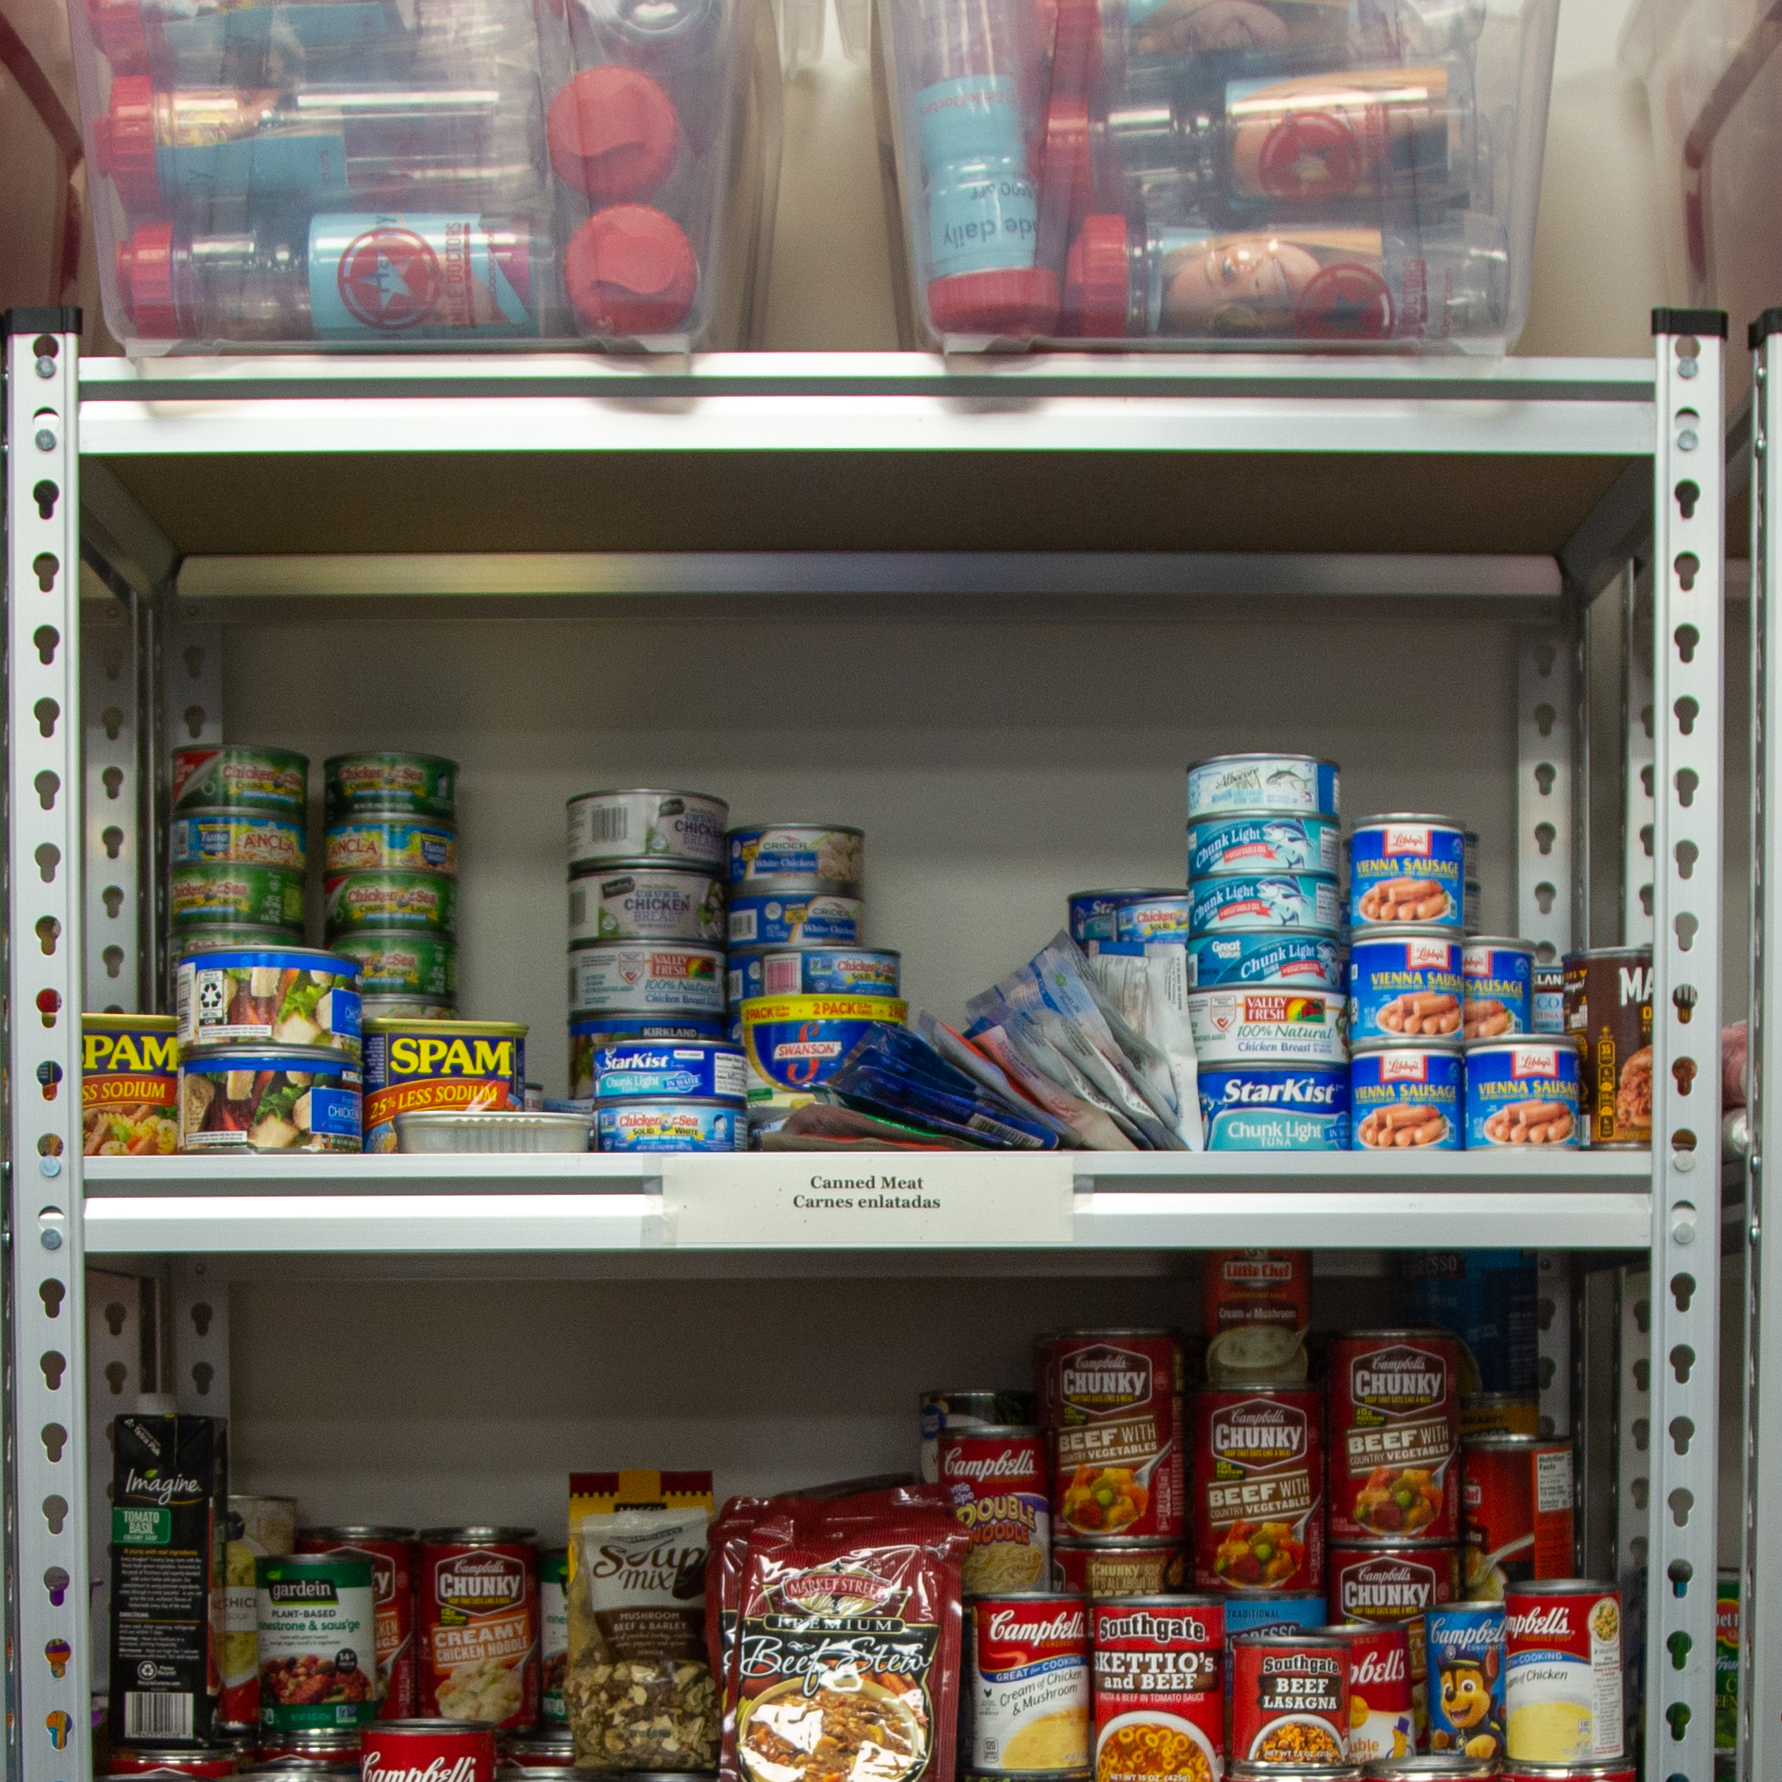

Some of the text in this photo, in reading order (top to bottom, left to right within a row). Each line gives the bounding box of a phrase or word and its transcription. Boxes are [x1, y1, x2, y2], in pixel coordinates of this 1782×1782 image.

[763, 839, 807, 851] CRIDER
[1246, 998, 1285, 1010] VALLEY
[643, 1026, 697, 1038] KIRKLAND
[391, 1039, 512, 1075] SPAM
[778, 1042, 836, 1057] SWANSON
[603, 1051, 669, 1071] StarKist
[99, 1081, 165, 1100] SODIUM
[1223, 1078, 1336, 1104] StarKist
[370, 1079, 498, 1124] 25% LESS SODIUM
[1228, 1121, 1321, 1142] Chunk Light
[810, 1176, 924, 1190] Canned Meat
[793, 1195, 940, 1209] Carnes enlatadas
[125, 1469, 201, 1505] Imagine
[123, 1510, 160, 1524] TOMATO
[1099, 1613, 1205, 1642] Southgate
[1275, 1678, 1325, 1694] BEEF
[1263, 1693, 1338, 1710] LASAGNA
